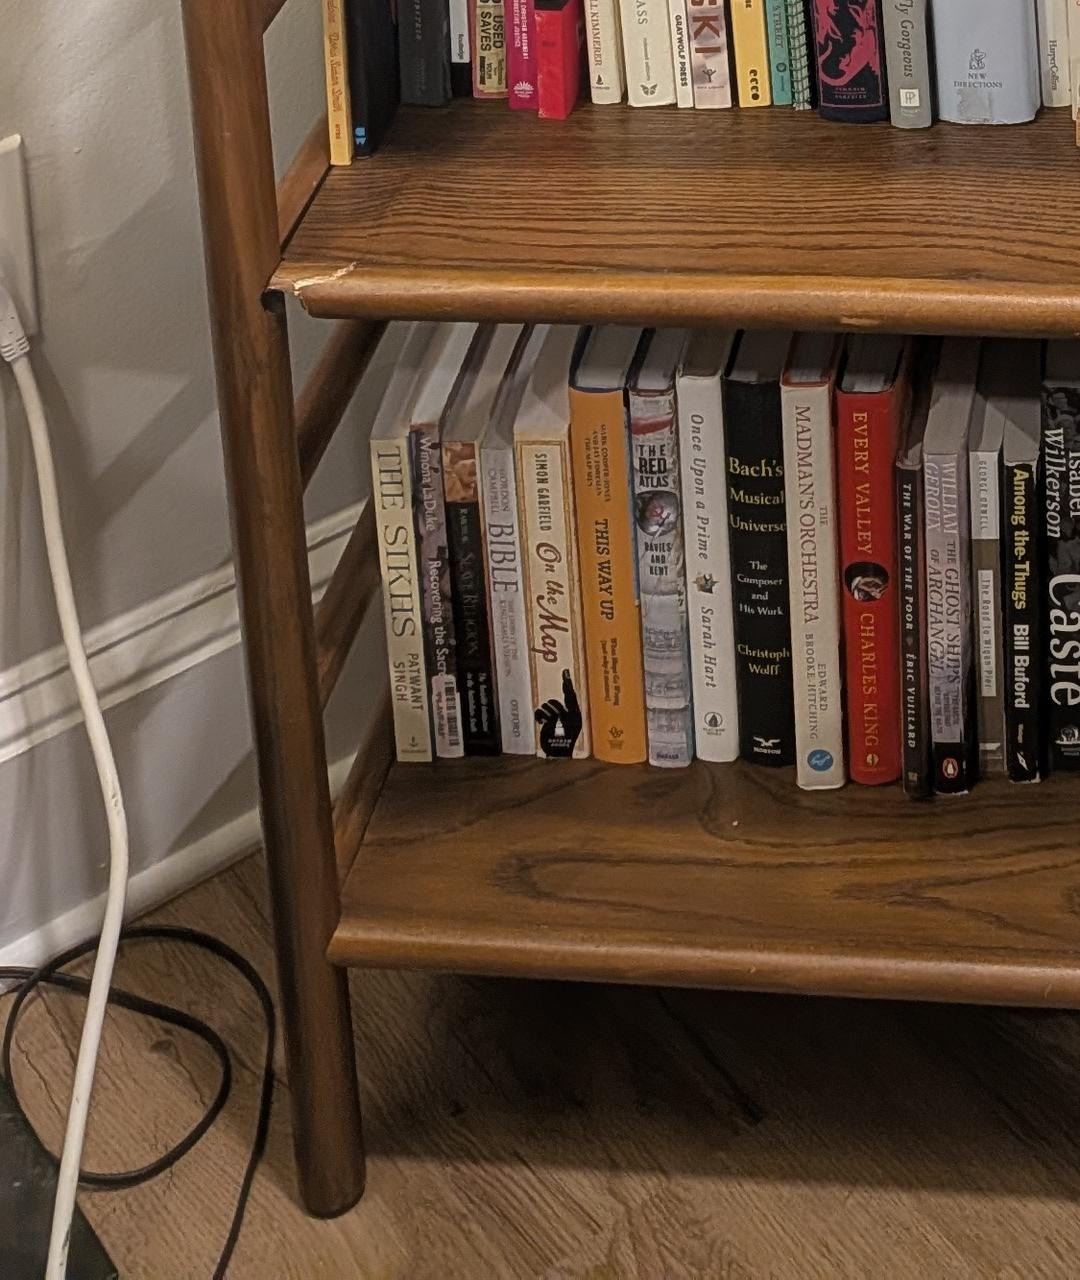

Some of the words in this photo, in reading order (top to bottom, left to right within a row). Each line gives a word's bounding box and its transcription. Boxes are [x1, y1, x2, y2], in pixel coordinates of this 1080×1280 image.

[954, 80, 1002, 89] DIRECTIONS
[638, 444, 666, 457] THE
[691, 414, 703, 452] Once
[853, 411, 869, 474] EVERY
[377, 445, 405, 510] THE
[535, 452, 547, 484] SIMON
[638, 457, 667, 475] RED
[639, 475, 669, 488] ATLAS
[690, 457, 706, 497] Upon
[729, 457, 783, 477] Bach's
[1045, 428, 1065, 538] Wilkerson
[537, 487, 551, 531] GARFIELD
[697, 501, 706, 509] a
[730, 488, 784, 506] Musical
[1013, 469, 1027, 525] Among
[594, 519, 610, 554] THIS
[731, 515, 786, 531] Universe
[855, 483, 872, 555] VALLEY
[697, 517, 709, 561] Prime
[1014, 530, 1029, 559] the
[537, 542, 562, 575] On
[384, 525, 416, 638] SIKHS
[546, 579, 564, 605] the
[597, 559, 612, 594] WAY
[1012, 561, 1030, 610] Thugs
[600, 600, 614, 620] UP
[701, 606, 713, 649] Sarah
[531, 597, 569, 663] Map
[1014, 624, 1029, 653] Bill
[861, 612, 876, 692] CHARLES
[703, 655, 715, 688] Hart
[1014, 655, 1030, 709] Buford
[864, 702, 878, 747] KING
